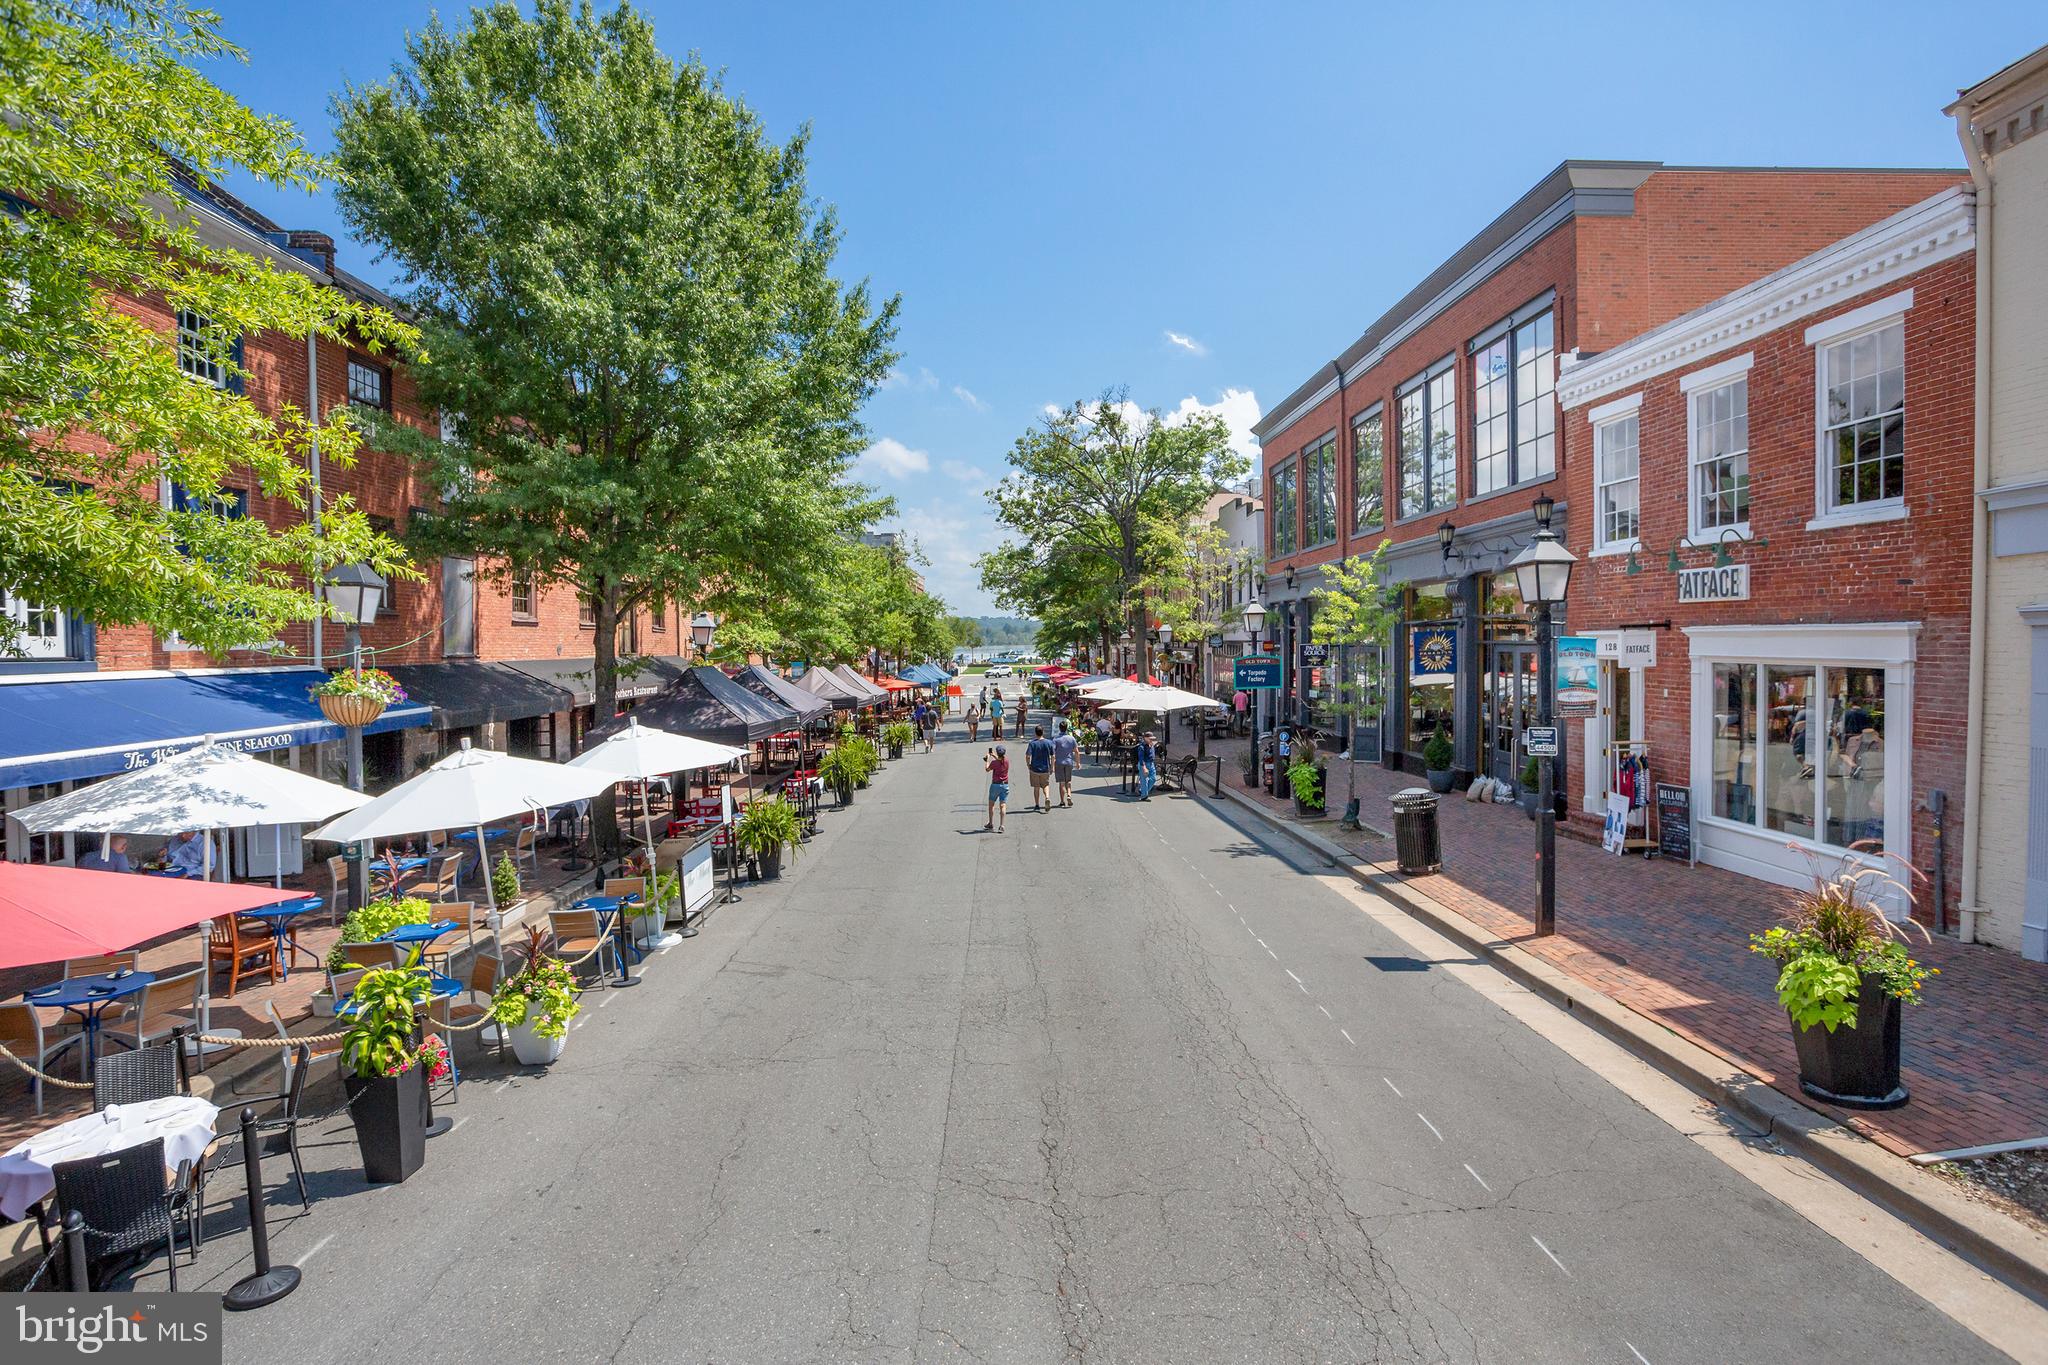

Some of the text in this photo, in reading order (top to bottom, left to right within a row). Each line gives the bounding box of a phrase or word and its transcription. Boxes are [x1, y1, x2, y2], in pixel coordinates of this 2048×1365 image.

[1678, 568, 1739, 599] FATFACE
[1605, 643, 1617, 651] 128
[1626, 645, 1650, 654] FATFACE
[245, 734, 292, 750] SEAFOOD
[124, 751, 149, 769] The
